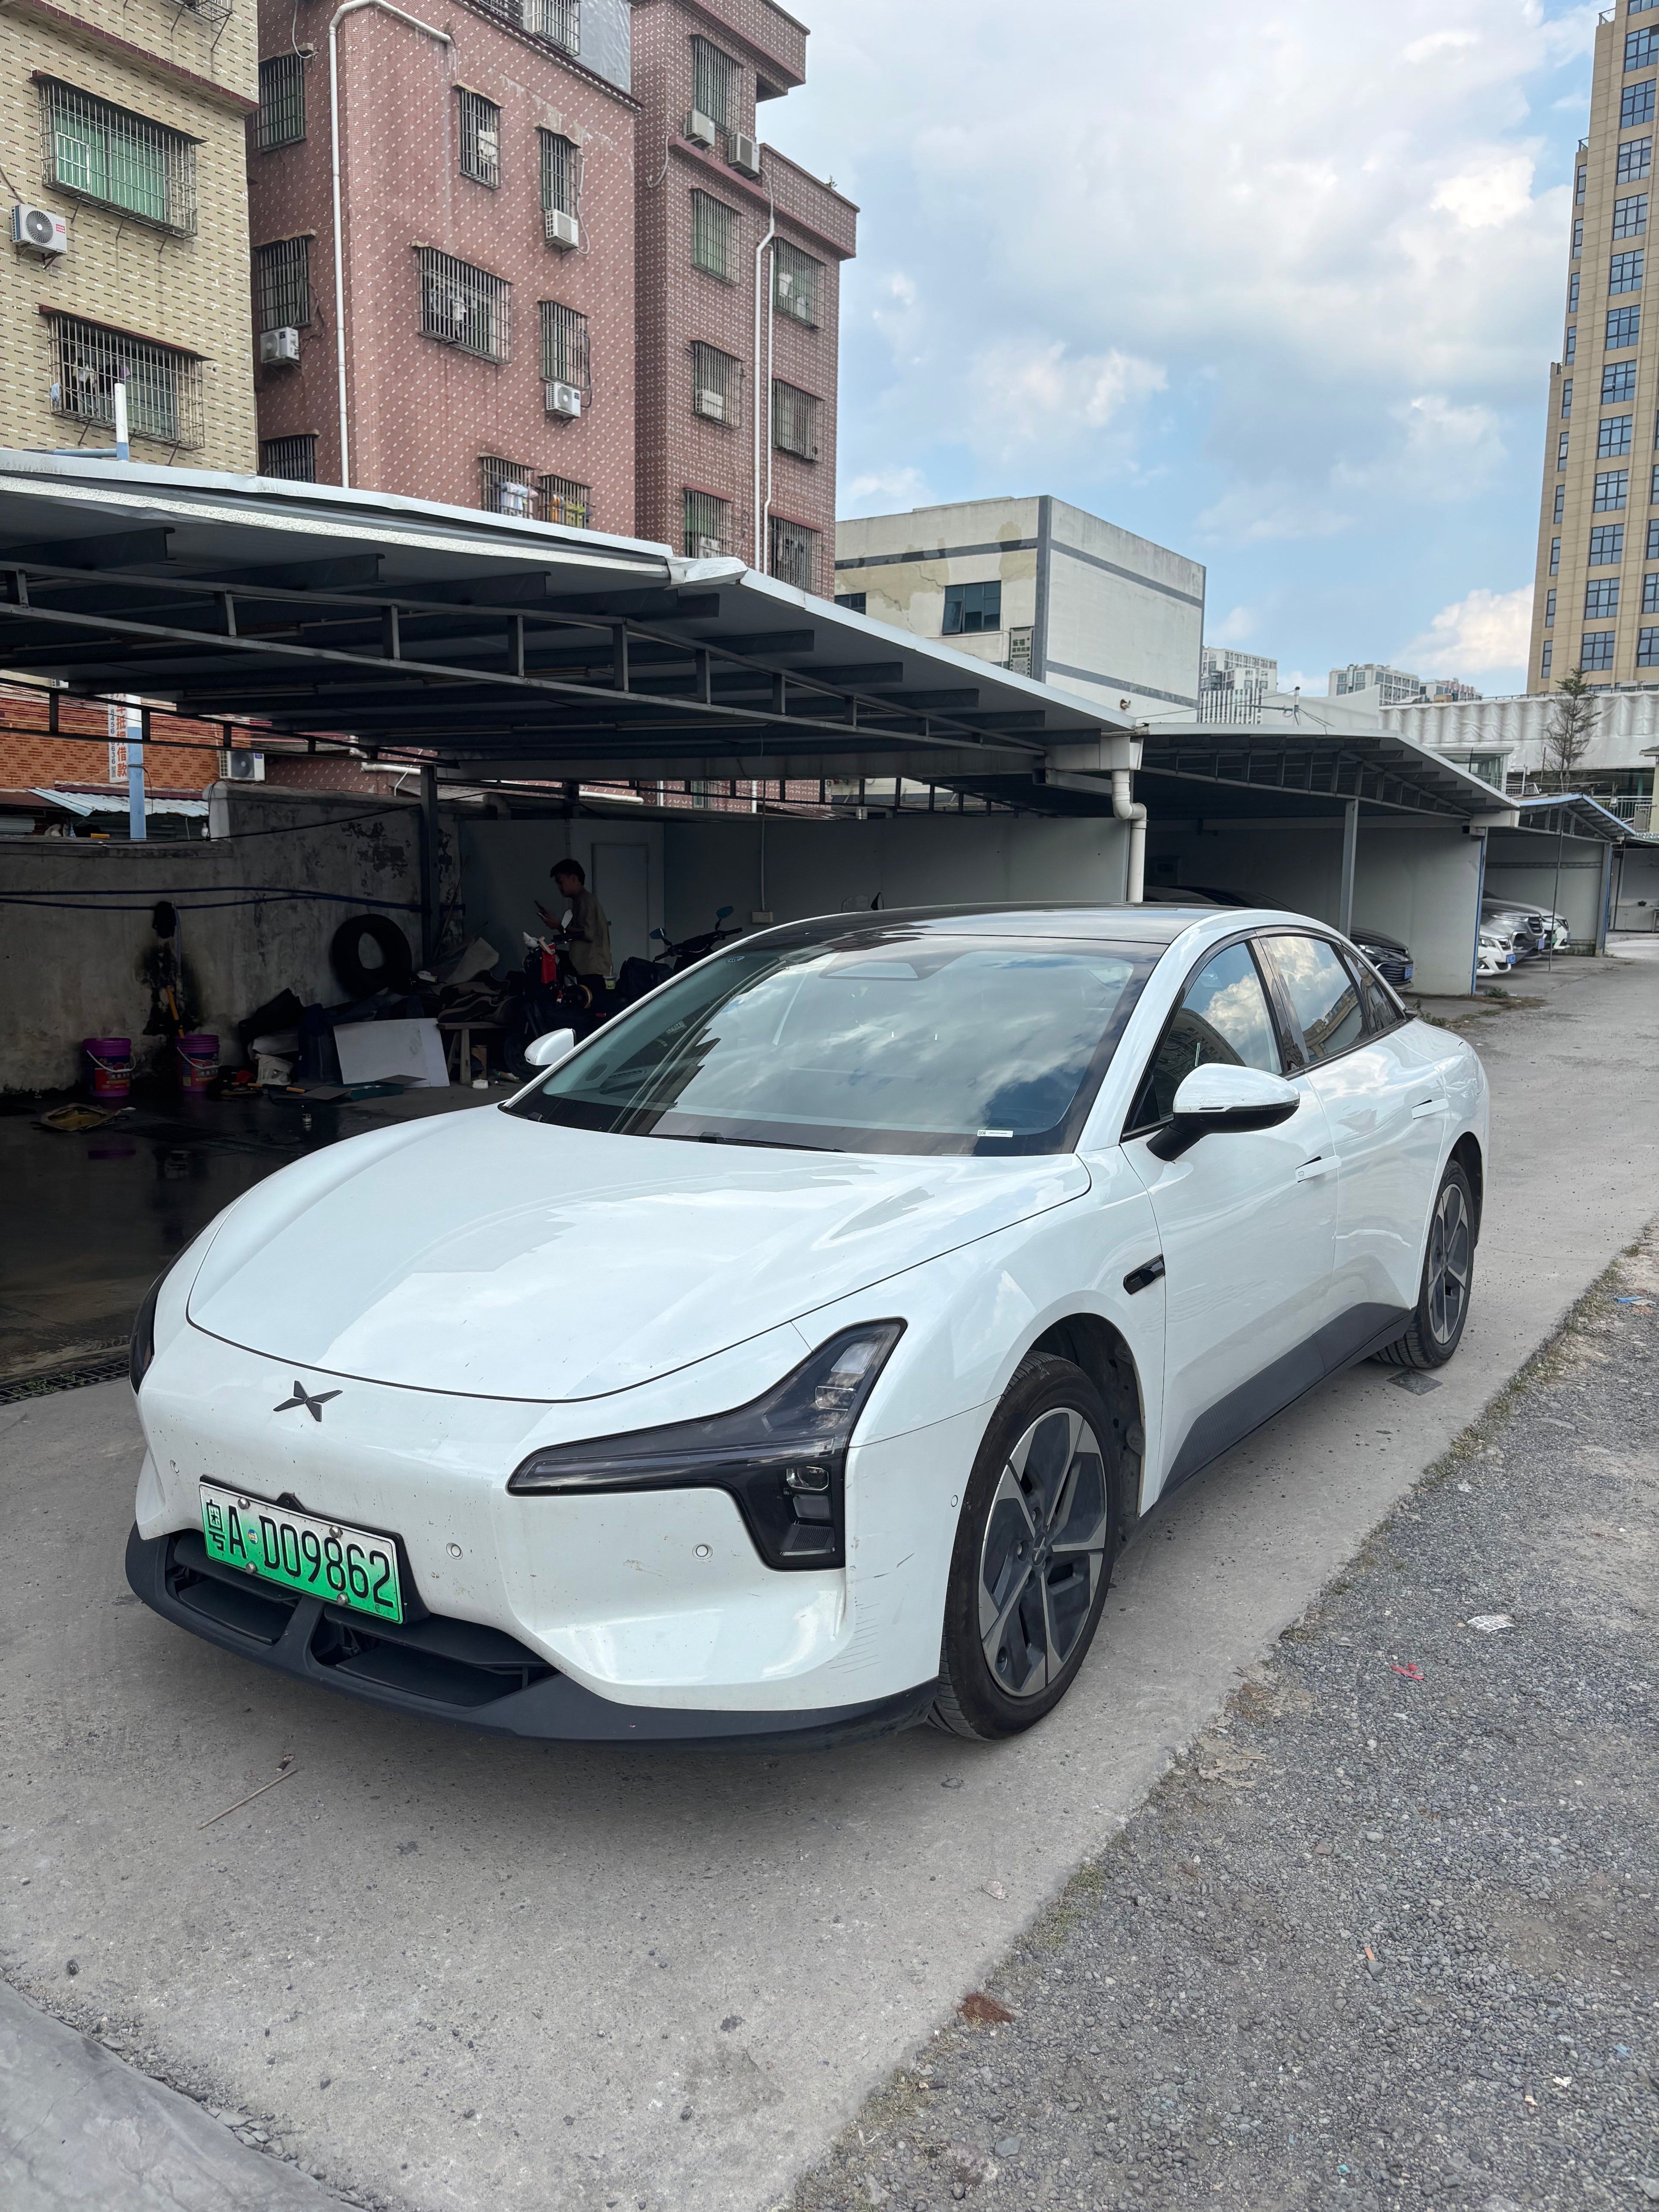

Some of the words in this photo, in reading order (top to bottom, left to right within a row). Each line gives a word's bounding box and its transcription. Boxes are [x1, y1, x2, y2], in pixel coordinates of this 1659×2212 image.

[116, 693, 127, 777] 车抵押借款
